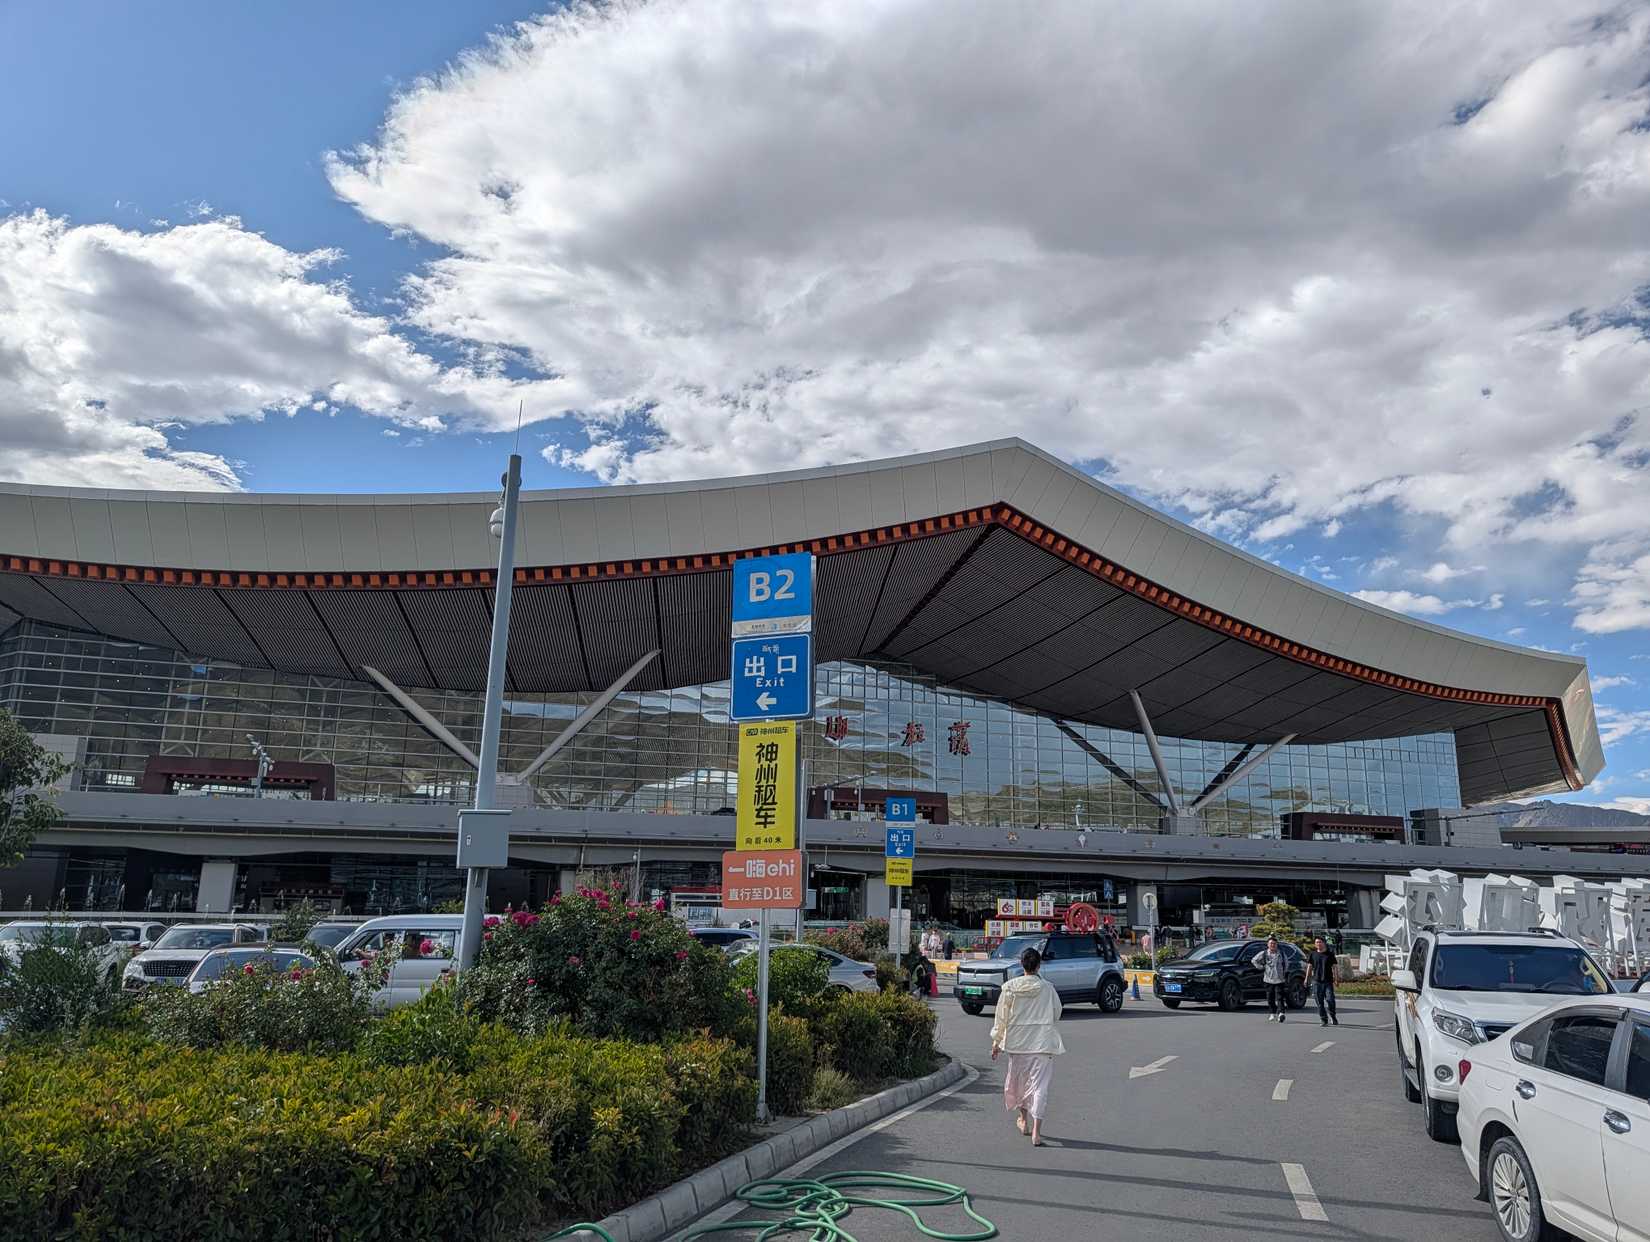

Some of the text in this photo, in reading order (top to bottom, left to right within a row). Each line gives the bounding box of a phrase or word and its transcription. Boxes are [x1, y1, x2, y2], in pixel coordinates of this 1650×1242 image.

[749, 569, 795, 603] B2
[744, 655, 797, 677] 出口
[755, 676, 785, 688] Exit
[753, 741, 779, 829] 神州租车
[891, 803, 908, 816] B1
[890, 833, 911, 842] 出口
[728, 886, 795, 902] 直行至D1区
